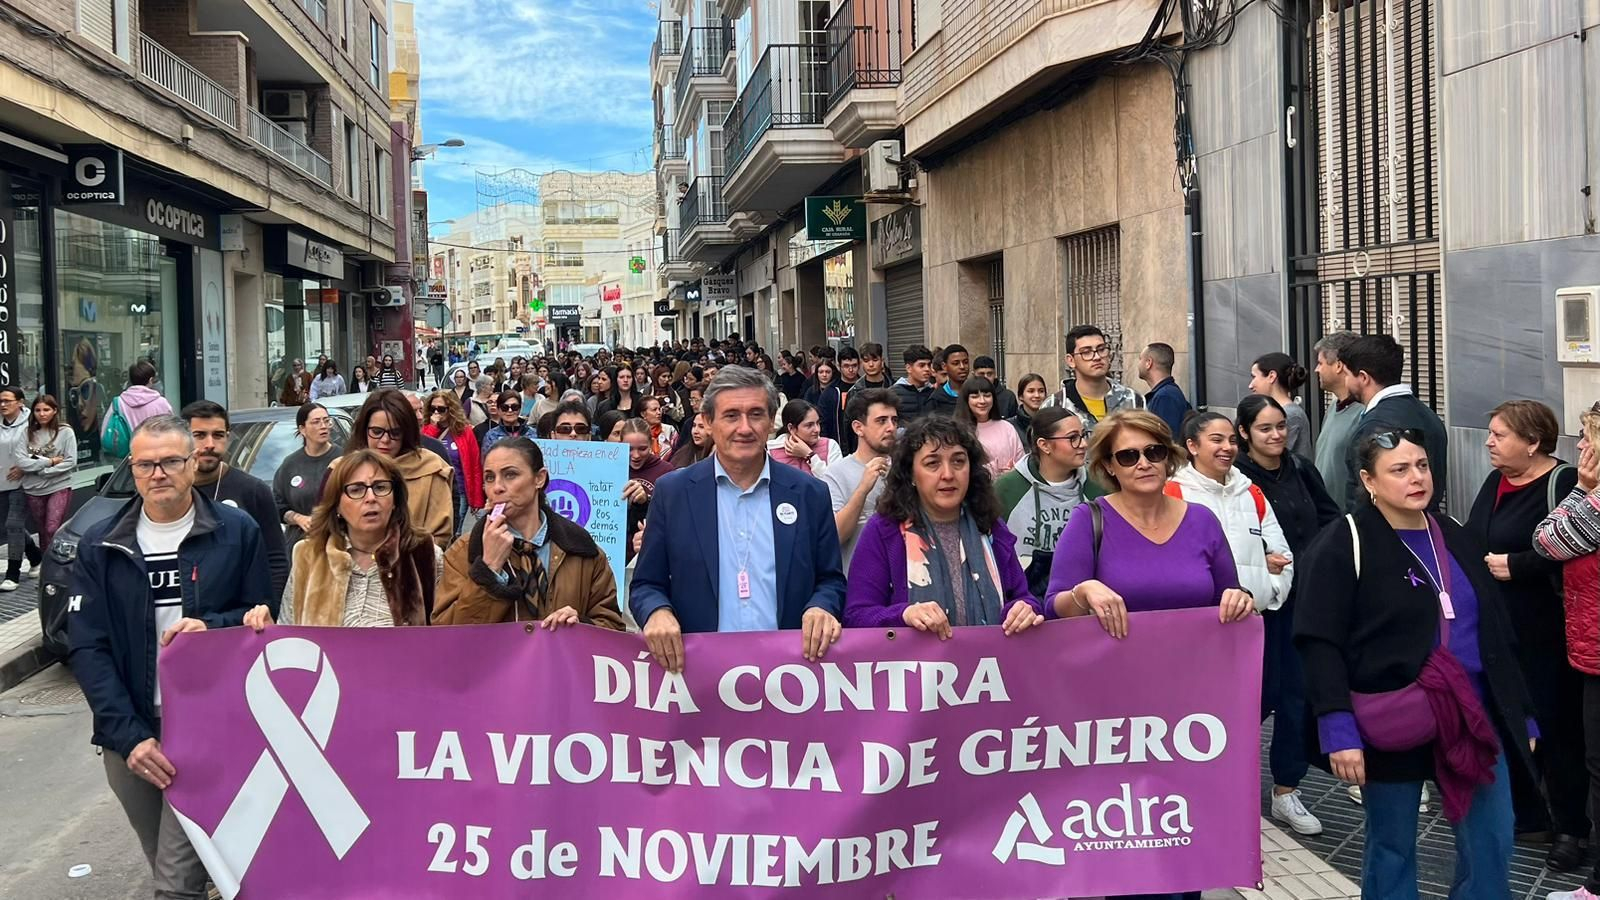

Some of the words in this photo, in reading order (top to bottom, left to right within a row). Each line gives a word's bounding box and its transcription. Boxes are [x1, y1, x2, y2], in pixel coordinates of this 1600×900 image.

[552, 307, 578, 316] farmacia
[561, 446, 593, 460] empieza
[595, 449, 606, 460] en
[607, 446, 620, 460] el
[546, 462, 574, 475] ULA
[588, 480, 614, 493] tratar
[592, 495, 610, 507] bien
[596, 508, 611, 520] los
[590, 520, 619, 532] demás
[591, 650, 700, 714] DÍA
[717, 656, 1011, 714] CONTRA
[396, 730, 472, 781] LA
[486, 731, 842, 791] VIOLENCIA
[861, 737, 940, 794] DE
[958, 712, 1228, 776] GÉNERO
[1061, 782, 1194, 840] adra
[1073, 836, 1192, 852] AYUNTAMIENTO
[427, 822, 492, 877] 25
[509, 828, 578, 880] de
[598, 820, 942, 887] NOVIEMBRE
